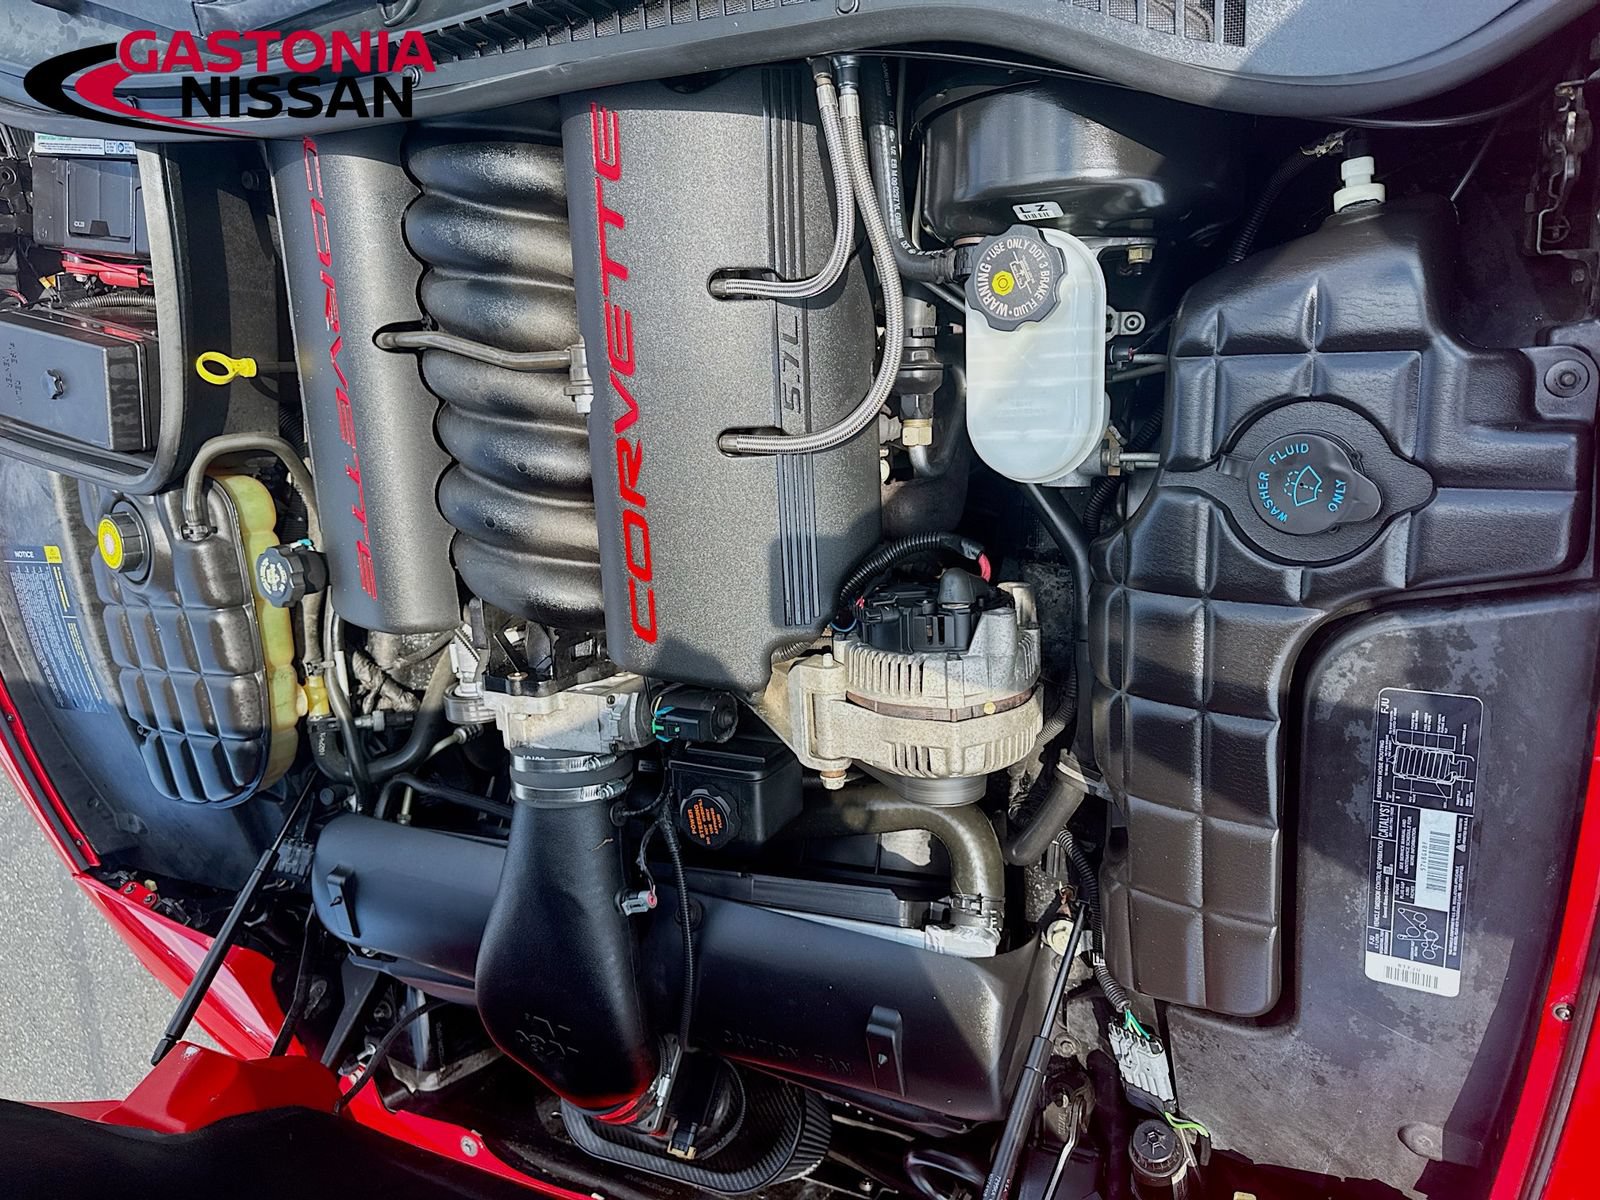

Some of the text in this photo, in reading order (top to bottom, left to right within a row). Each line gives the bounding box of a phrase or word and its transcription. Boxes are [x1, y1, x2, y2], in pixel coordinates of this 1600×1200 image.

[989, 242, 1006, 259] USE
[1006, 239, 1030, 250] ONLY
[1029, 244, 1045, 262] DOT
[1039, 261, 1049, 269] 3
[978, 263, 1008, 317] WARNING
[1036, 271, 1050, 301] BRAKE
[1014, 298, 1038, 317] FLUID
[303, 136, 378, 600] CORVETTE
[590, 102, 658, 645] CORVETTE
[779, 315, 809, 413] 5.7L
[1257, 443, 1347, 522] WASHER FLUID ONLY
[1381, 698, 1389, 713] FJU
[688, 809, 696, 834] POWER
[694, 805, 704, 838] STEERING
[1379, 804, 1390, 837] CATALYST
[724, 1030, 855, 1074] CAUTION FAN
